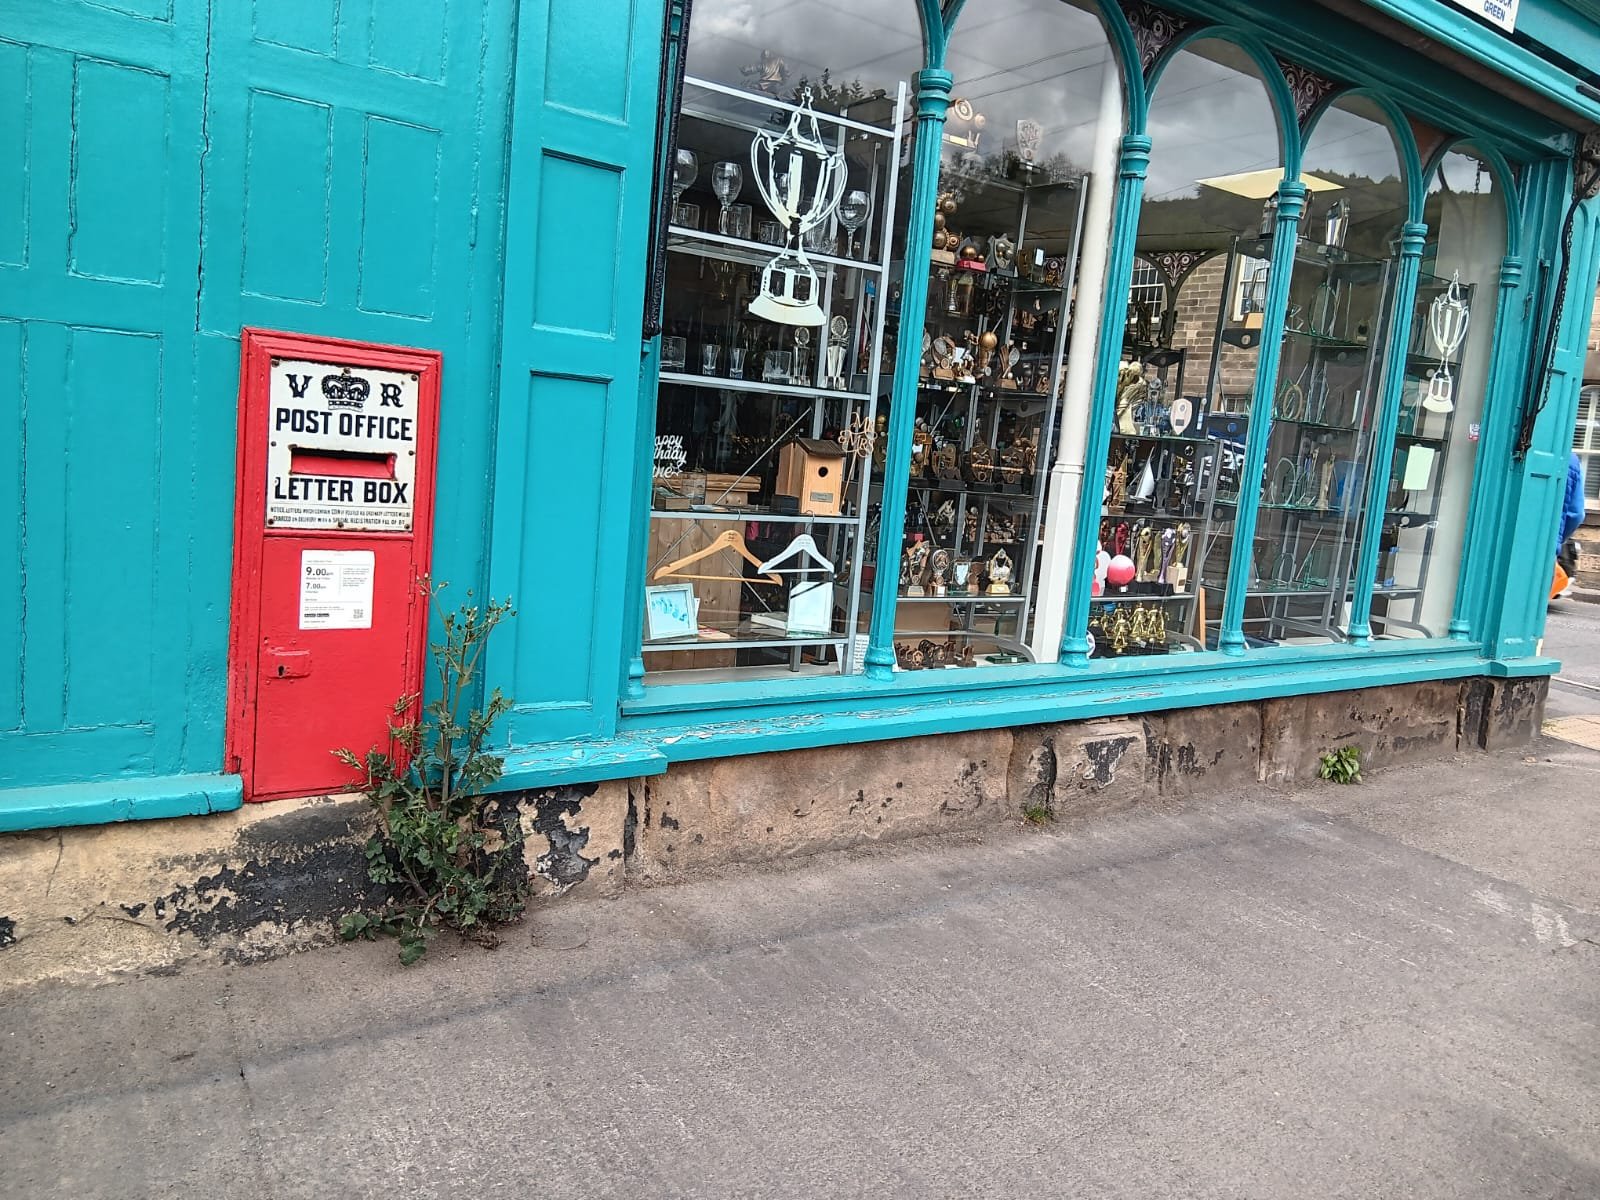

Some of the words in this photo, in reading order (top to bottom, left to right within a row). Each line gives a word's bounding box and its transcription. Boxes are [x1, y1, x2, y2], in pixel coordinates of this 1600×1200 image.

[1484, 0, 1506, 22] GREEN
[285, 373, 313, 399] V
[379, 382, 404, 408] R
[275, 407, 333, 435] POST
[339, 412, 413, 441] OFFICE
[655, 434, 683, 449] appy
[274, 476, 353, 503] LETTER
[363, 481, 408, 504] BOX
